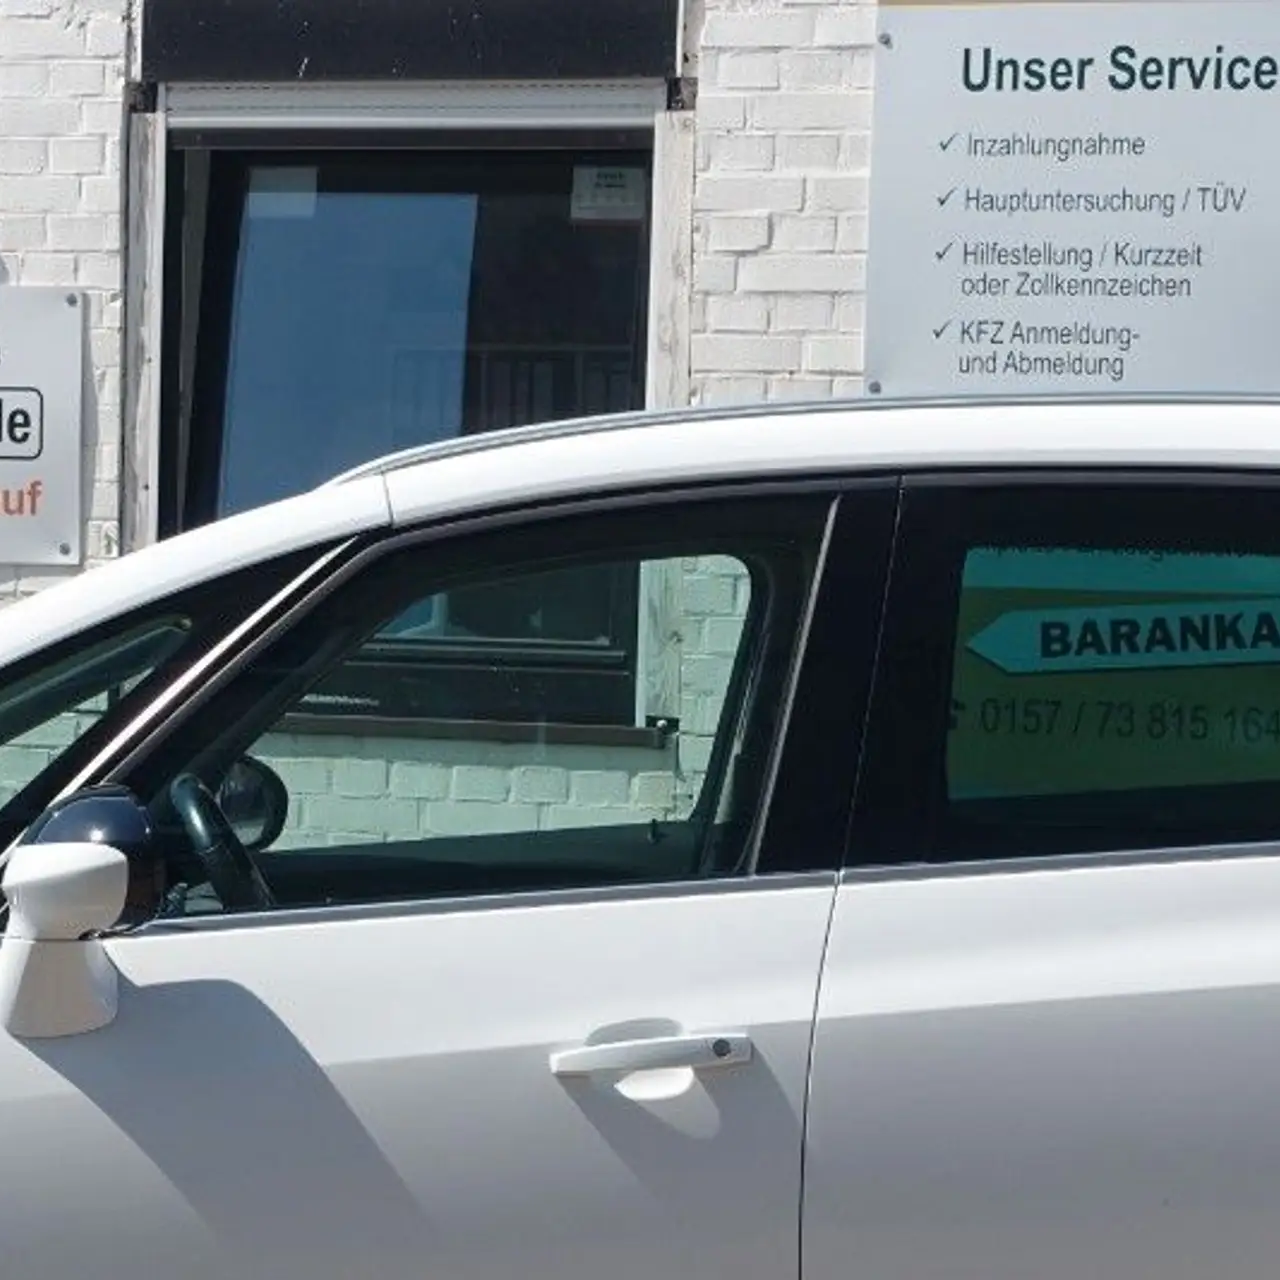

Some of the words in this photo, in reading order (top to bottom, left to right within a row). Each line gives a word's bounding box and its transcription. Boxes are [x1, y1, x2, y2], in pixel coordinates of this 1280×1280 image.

[963, 48, 1094, 92] Unser
[967, 132, 1146, 163] Inzahlungnahme
[964, 188, 1176, 219] Hauptuntersuchung
[1181, 188, 1192, 213] /
[1197, 182, 1247, 213] TÜV
[963, 242, 1093, 269] Hilfestellung
[1098, 242, 1109, 268] /
[1115, 242, 1202, 267] Kurzzeit
[961, 272, 1011, 297] oder
[1015, 271, 1192, 297] Zollkennzeichen
[960, 320, 1005, 345] KFZ
[1008, 320, 1140, 351] Anmeldung-
[958, 350, 998, 374] und
[1003, 351, 1126, 382] Abmeldung
[979, 699, 1063, 735] 0157
[1096, 702, 1135, 738] 73
[1148, 704, 1209, 741] 815
